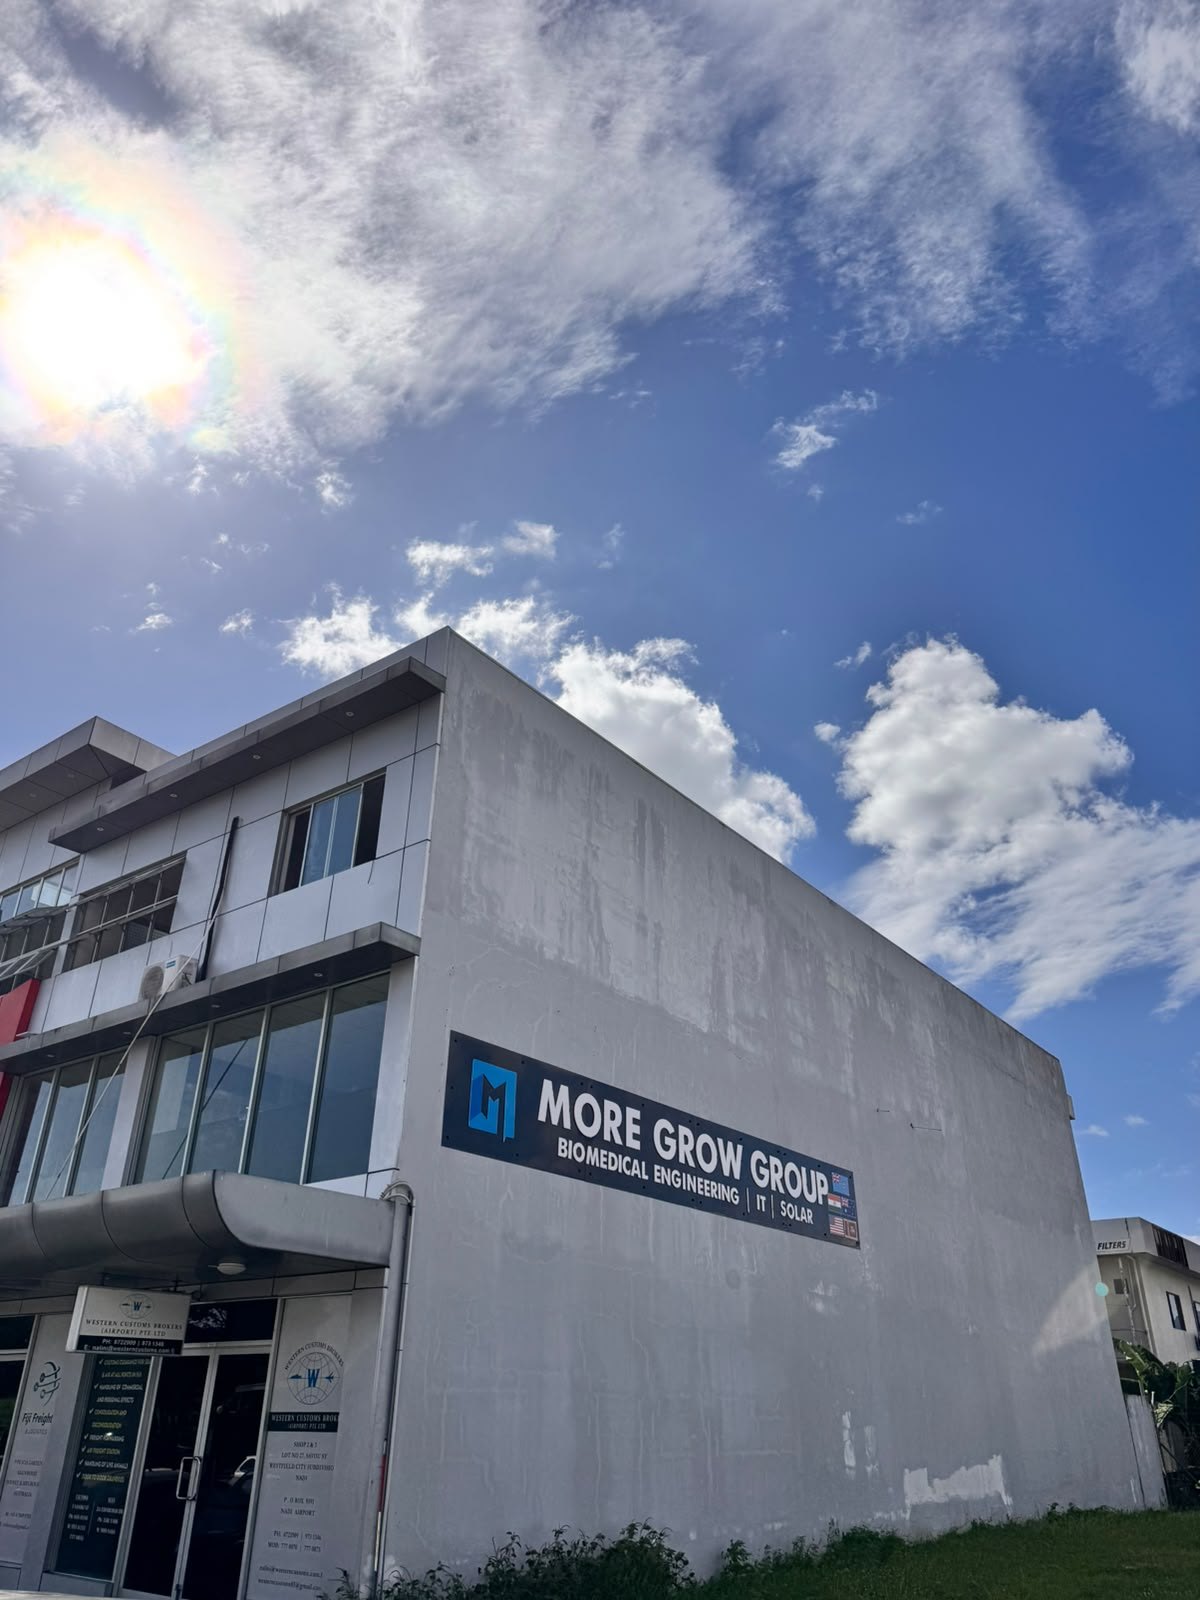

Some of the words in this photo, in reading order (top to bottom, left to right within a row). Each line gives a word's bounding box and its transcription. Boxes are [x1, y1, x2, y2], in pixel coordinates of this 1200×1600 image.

[537, 1078, 641, 1151] MORE
[653, 1118, 743, 1180] GROW
[750, 1150, 829, 1205] GROUP
[557, 1136, 649, 1180] BIOMEDICAL
[653, 1164, 740, 1206] ENGINEERING
[756, 1193, 767, 1212] IT
[780, 1200, 814, 1225] SOLAR
[1097, 1241, 1127, 1250] FILTERS
[133, 1301, 143, 1311] W
[86, 1319, 118, 1327] WESTERN
[120, 1321, 151, 1329] CUSTOMS
[307, 1368, 320, 1388] W
[32, 1412, 54, 1426] Freight
[272, 1414, 295, 1422] WESTERN
[297, 1414, 321, 1422] CUSTOMS
